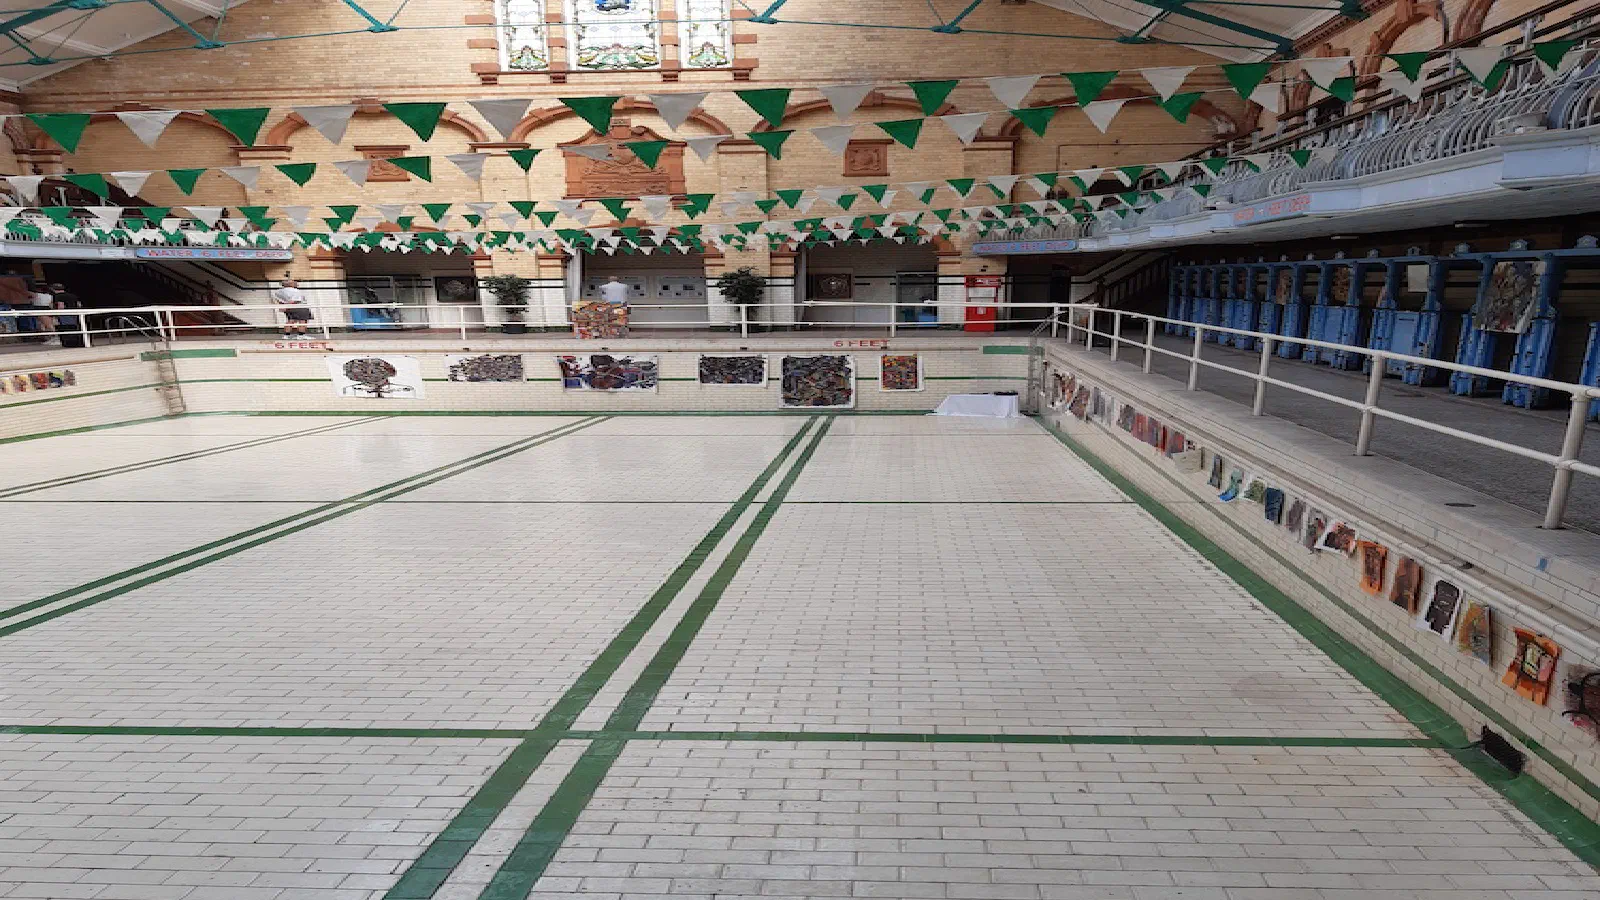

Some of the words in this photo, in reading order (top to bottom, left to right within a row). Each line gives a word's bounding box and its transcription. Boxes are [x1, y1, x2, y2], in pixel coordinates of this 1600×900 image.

[146, 249, 193, 257] WATER
[217, 250, 247, 258] FEET
[833, 340, 844, 348] 6
[848, 339, 888, 347] FEET
